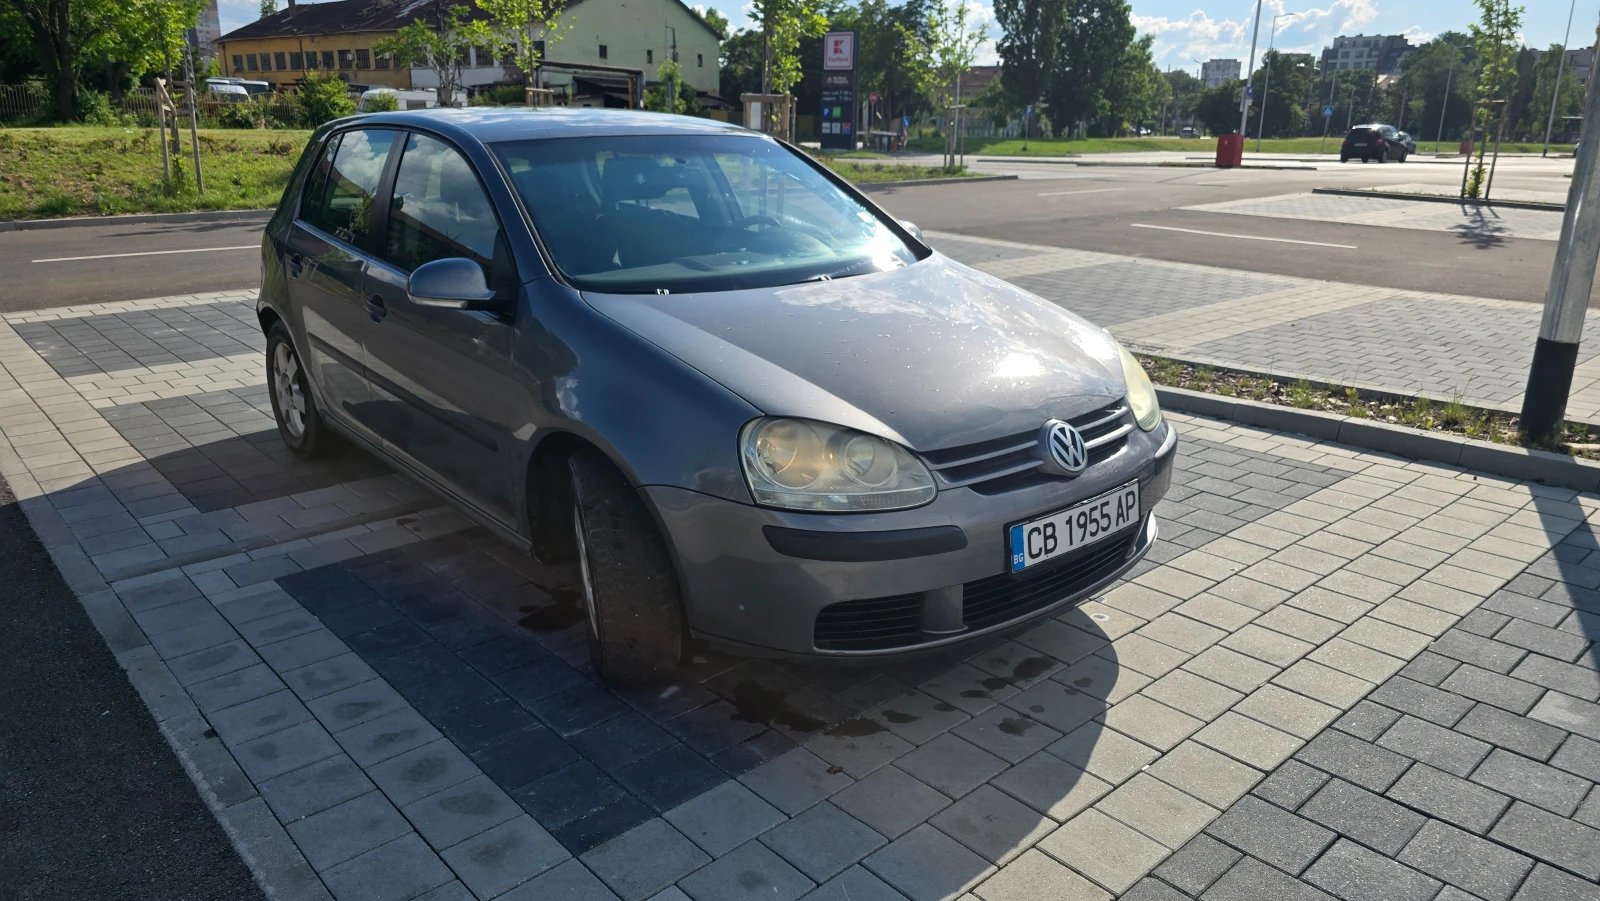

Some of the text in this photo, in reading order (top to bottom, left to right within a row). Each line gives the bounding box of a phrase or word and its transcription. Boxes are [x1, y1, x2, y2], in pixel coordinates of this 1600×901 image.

[833, 39, 844, 54] K
[1049, 420, 1087, 470] VW
[1027, 490, 1136, 560] CB 1955 AP
[1013, 553, 1024, 565] BG
